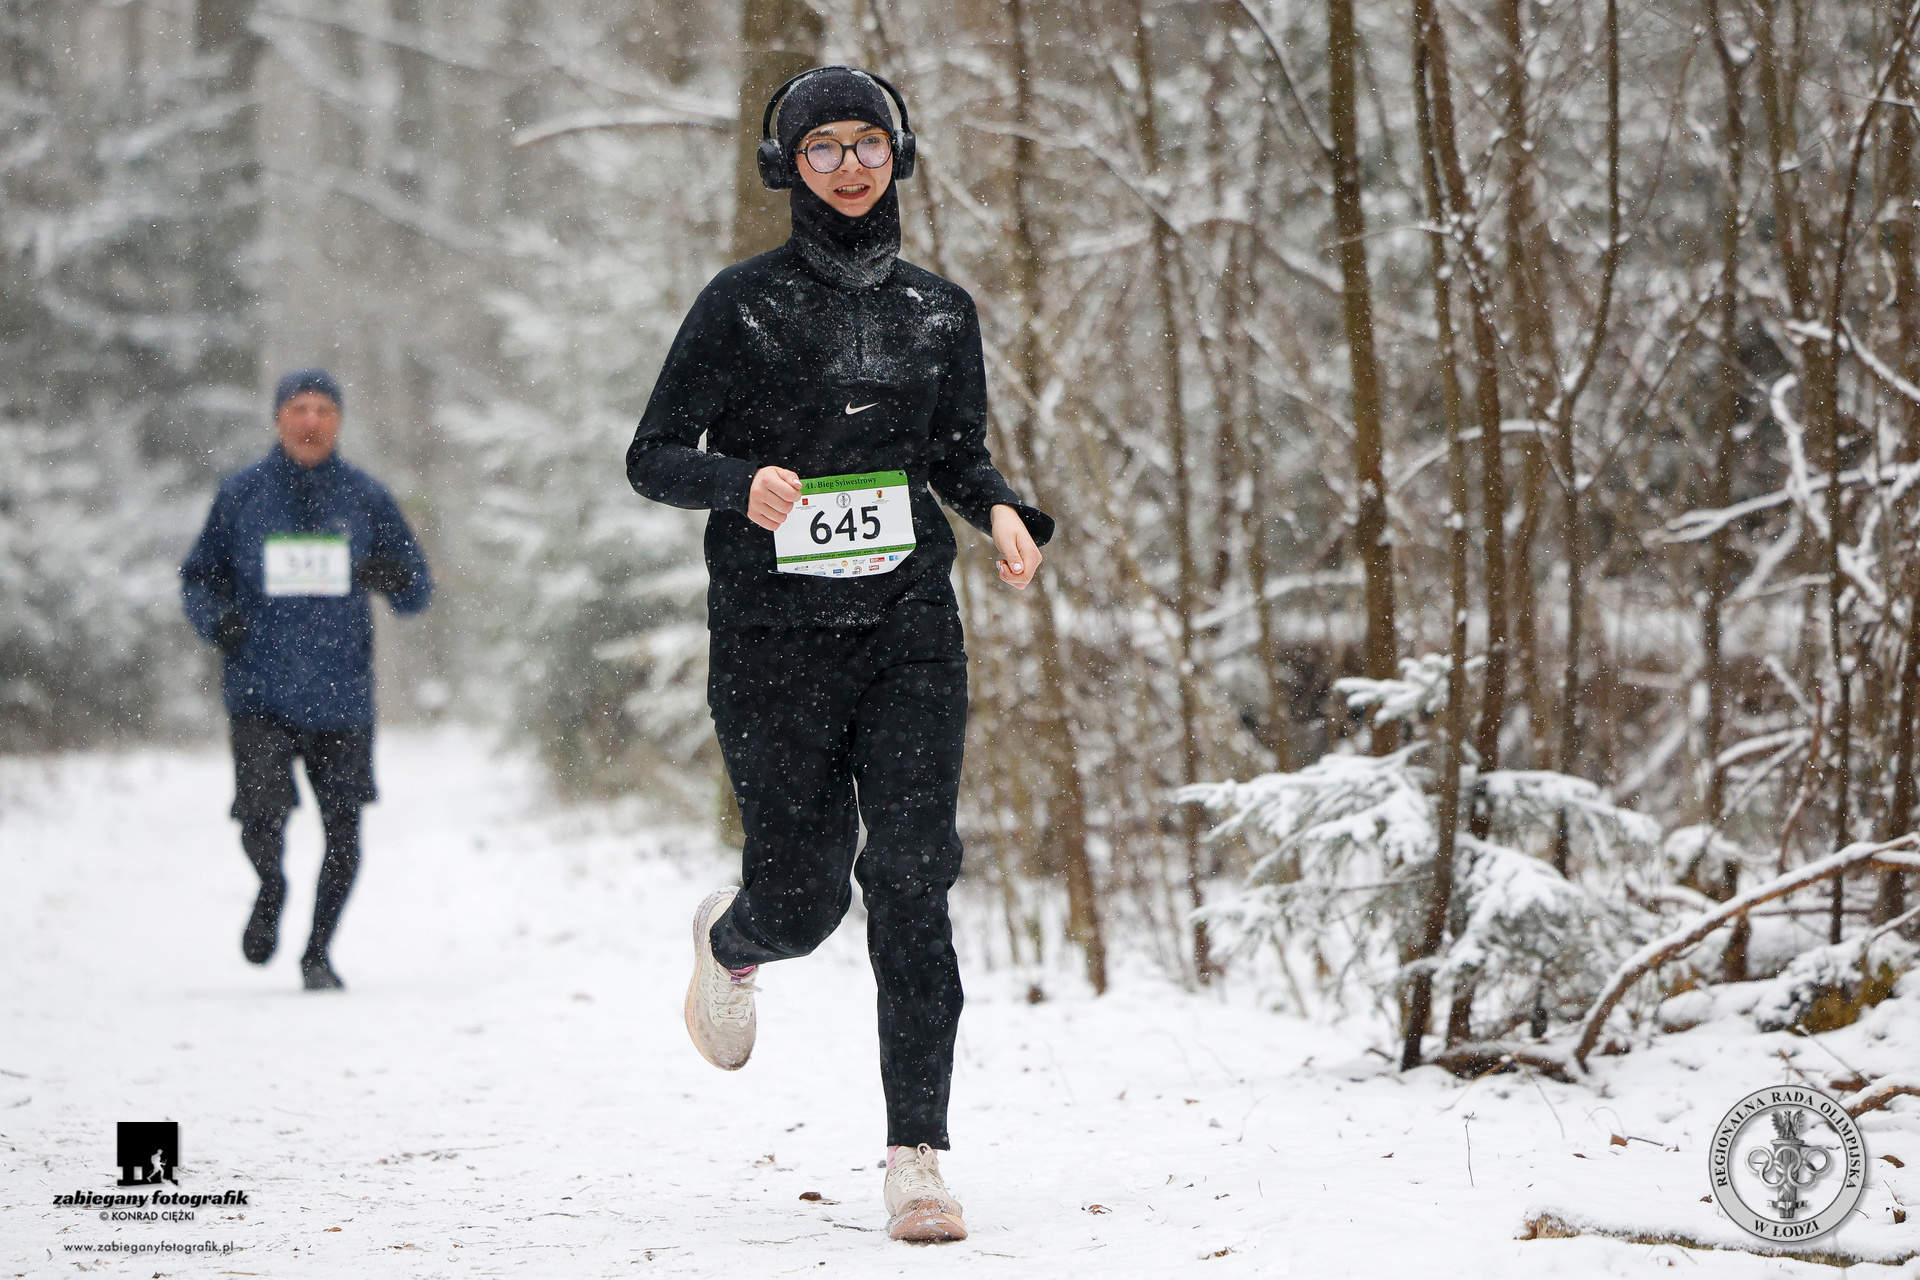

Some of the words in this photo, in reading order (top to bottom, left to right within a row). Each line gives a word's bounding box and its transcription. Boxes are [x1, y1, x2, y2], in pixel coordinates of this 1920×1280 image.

[818, 480, 834, 489] Bieg
[835, 477, 877, 488] Sylwestrowy
[810, 505, 881, 545] 645
